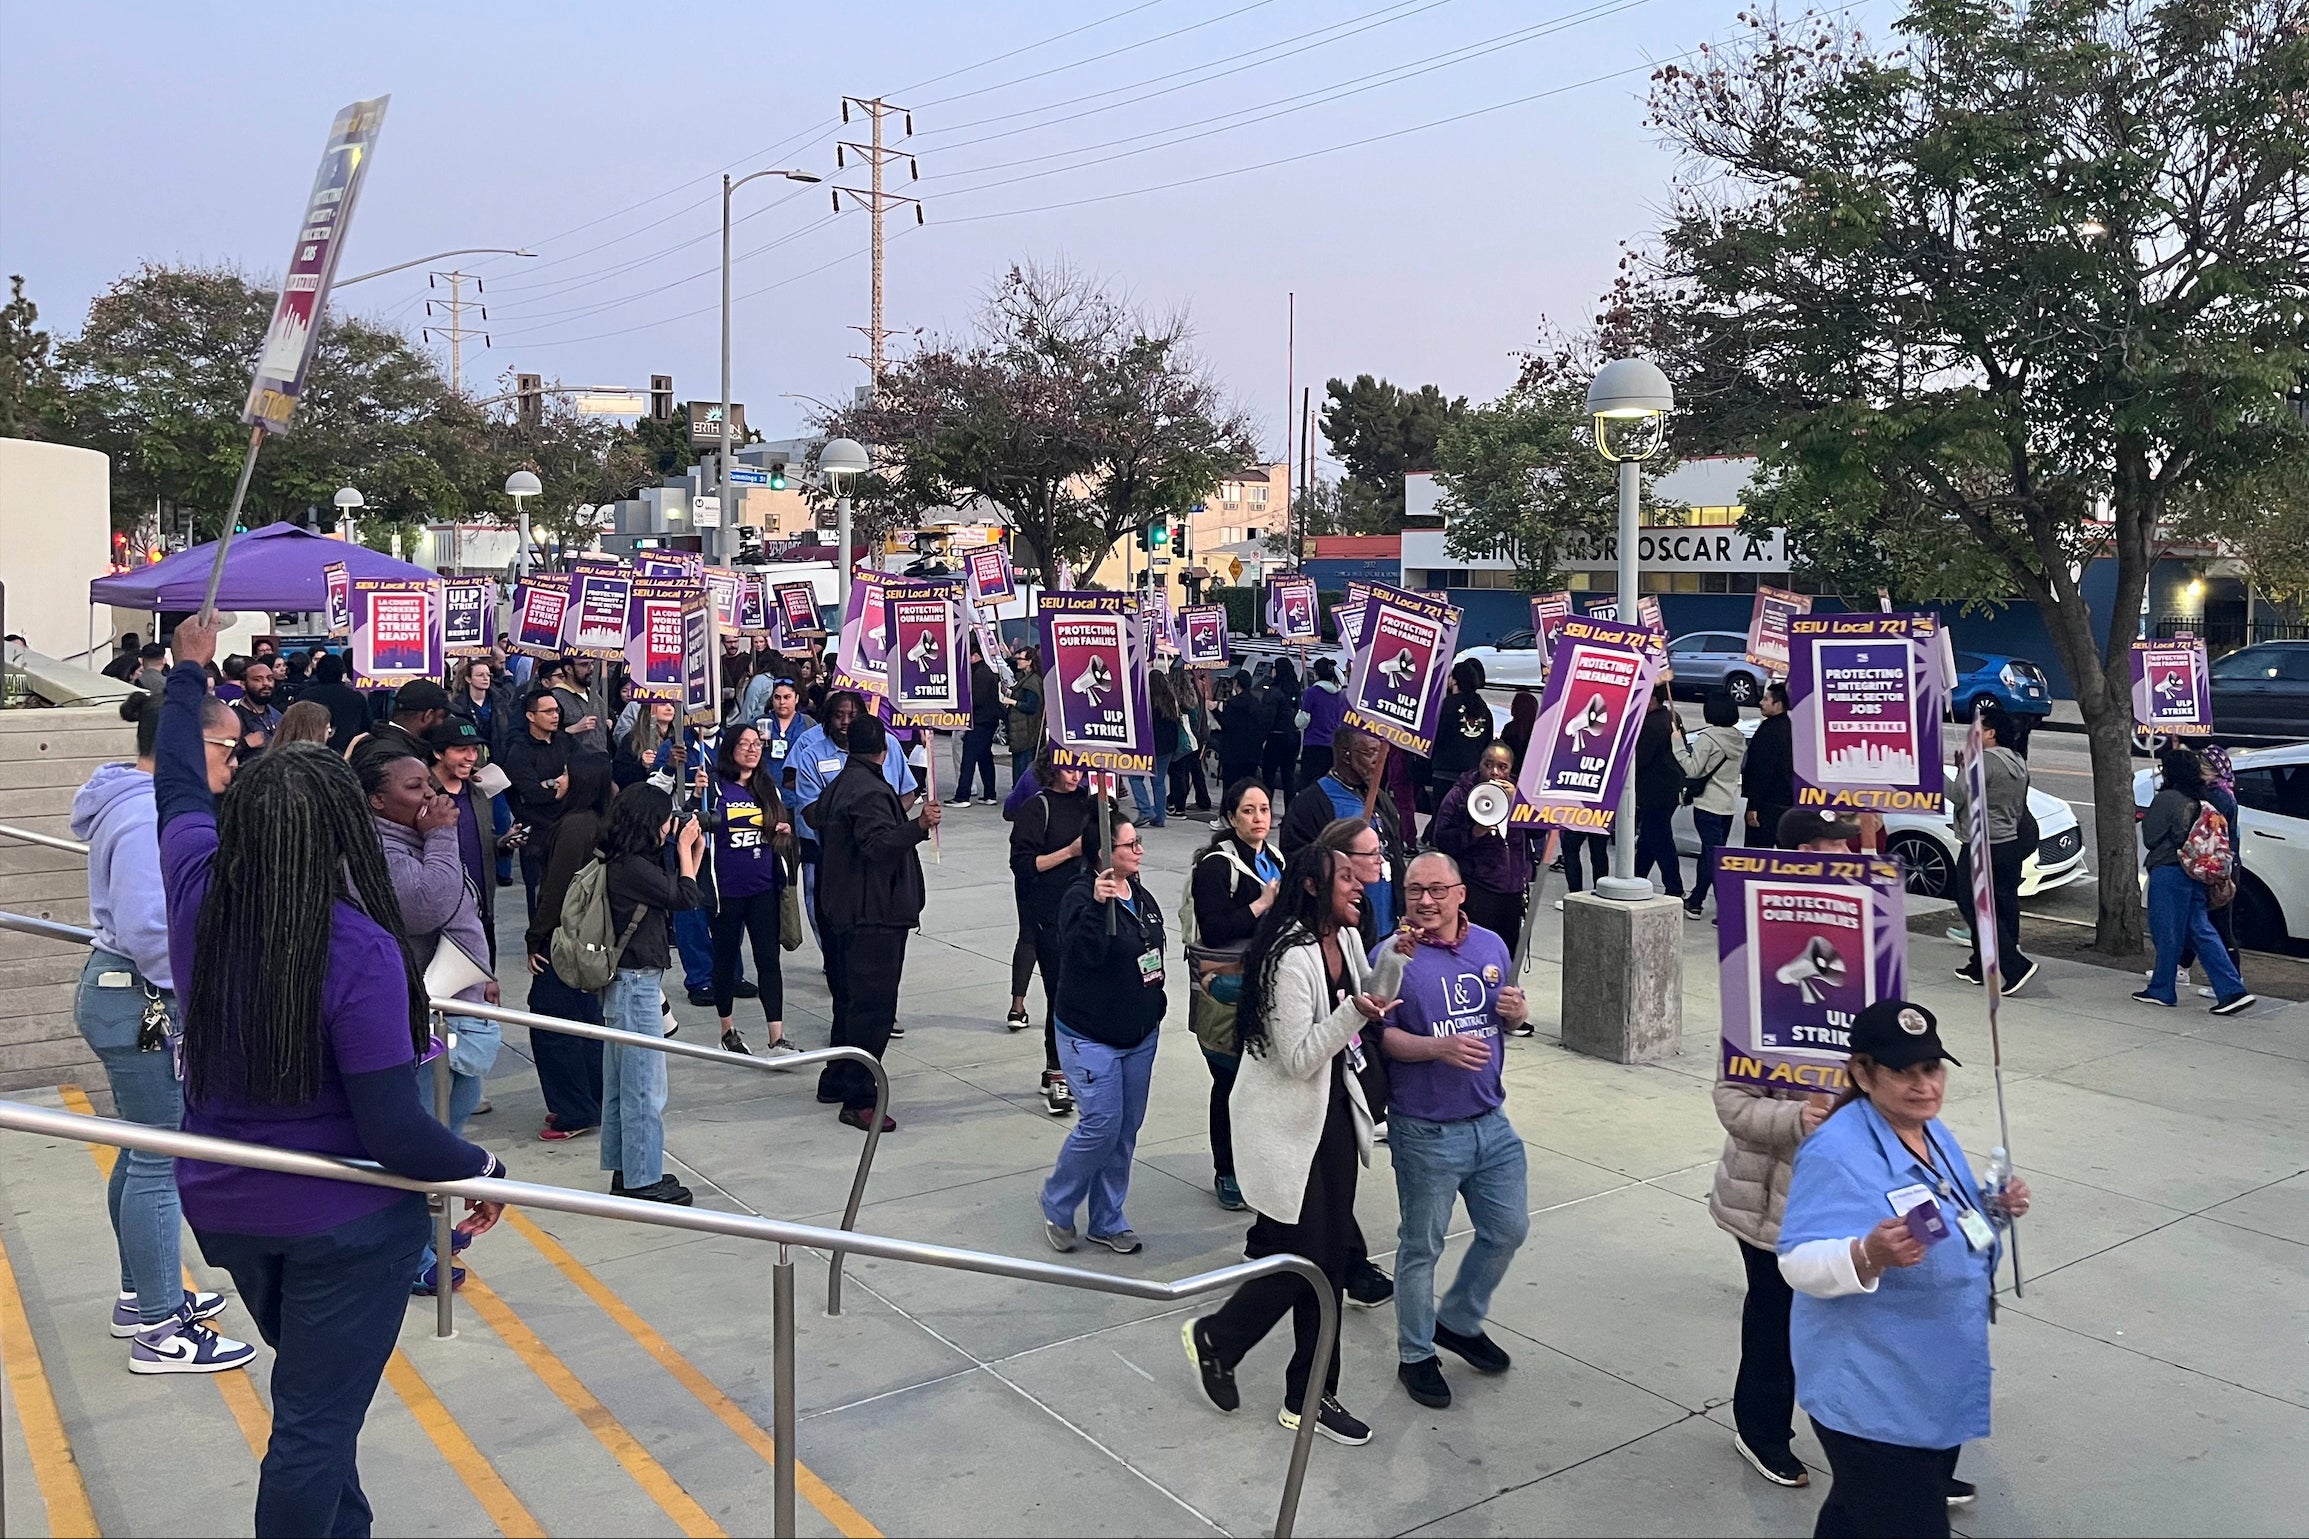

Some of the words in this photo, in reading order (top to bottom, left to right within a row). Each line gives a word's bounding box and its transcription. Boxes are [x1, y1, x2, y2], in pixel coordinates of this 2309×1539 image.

[693, 422, 719, 433] ERTH
[1638, 536, 1731, 562] OSCAR
[575, 566, 594, 574] SEIU
[595, 568, 617, 576] Local
[618, 570, 631, 579] 721
[856, 571, 880, 583] SEIU
[471, 578, 484, 586] 721
[520, 578, 537, 586] SEIU
[537, 581, 556, 589] Local
[557, 584, 569, 592] 721
[449, 590, 479, 602] ULP
[587, 590, 625, 598] PROTECTING
[632, 589, 655, 598] SEIU
[656, 589, 681, 598] Local
[885, 589, 906, 600] SEIU
[908, 588, 930, 598] Local
[933, 587, 949, 597] 721
[448, 602, 479, 610] STRIKE
[531, 603, 546, 612] ARE
[1040, 597, 1065, 609] SEIU
[1068, 597, 1097, 609] Local
[1100, 598, 1120, 610] 721
[1371, 587, 1395, 603] SEIU
[1395, 594, 1422, 611] Local
[1423, 604, 1443, 618] 721
[529, 610, 559, 621] STRIKE
[899, 606, 944, 615] PROTECTING
[377, 613, 400, 622] ARE
[401, 613, 420, 622] ULP
[527, 616, 557, 628] READY!
[900, 615, 915, 623] OUR
[915, 614, 944, 623] FAMILIES
[377, 622, 420, 631] STRIKE
[651, 625, 673, 634] ARE
[1058, 625, 1116, 636] PROTECTING
[1382, 616, 1434, 638] PROTECTING
[1791, 620, 1829, 633] SEIU
[1832, 620, 1874, 633] Local
[1879, 620, 1907, 634] 721
[377, 632, 420, 641] READY!
[1381, 625, 1399, 637] OUR
[1398, 630, 1432, 648] FAMILIES
[1563, 622, 1593, 638] SEIU
[1594, 627, 1624, 643] Local
[1624, 632, 1647, 648] 721
[1059, 636, 1080, 646] OUR
[1081, 636, 1117, 647] FAMILIES
[2153, 641, 2175, 649] Local
[2177, 641, 2191, 649] 721
[447, 647, 492, 656] ACTION!
[507, 645, 521, 654] IN
[564, 647, 579, 657] IN
[651, 644, 681, 653] READ
[1578, 656, 1634, 674] PROTECTING
[929, 674, 947, 684] ULP
[1576, 670, 1593, 681] OUR
[1593, 671, 1631, 687] FAMILIES
[1825, 668, 1904, 680] PROTECTING
[355, 677, 374, 688] IN
[834, 674, 853, 688] IN
[1837, 682, 1894, 691] INTEGRITY
[633, 688, 650, 699] IN
[914, 685, 947, 696] STRIKE
[1397, 693, 1417, 707] ULP
[1827, 692, 1860, 701] PUBLIC
[1861, 692, 1905, 702] SECTOR
[1376, 699, 1415, 721] STRIKE
[1850, 703, 1882, 715] JOBS
[2162, 707, 2193, 715] STRIKE
[892, 713, 909, 726] IN
[910, 713, 971, 727] ACTION!
[1103, 710, 1124, 722] ULP
[1084, 723, 1125, 738] STRIKE
[1343, 710, 1362, 728] IN
[1363, 720, 1432, 753] ACTION!
[1831, 722, 1853, 731] ULP
[1859, 721, 1904, 731] STRIKE
[2137, 725, 2151, 734] IN
[2153, 724, 2211, 734] ACTION!
[1053, 749, 1073, 766] IN
[1076, 750, 1154, 771] ACTION!
[1580, 756, 1606, 772] ULP
[1556, 771, 1602, 788] STRIKE
[1799, 787, 1827, 805] IN
[1831, 790, 1942, 810] ACTION!
[1511, 804, 1537, 822] IN
[1537, 805, 1614, 828] ACTION!
[1719, 855, 1766, 873] SEIU
[1769, 859, 1823, 876] Local
[1829, 861, 1865, 878] 721
[1762, 894, 1859, 915] PROTECTING
[1762, 909, 1796, 922] OUR
[1797, 911, 1859, 929] FAMILIES
[1455, 1014, 1488, 1029] CONTRACT
[1433, 1019, 1456, 1038] NO
[1792, 1025, 1852, 1048] STRIK
[1729, 1055, 1764, 1078] IN
[1769, 1060, 1851, 1088] ACTI
